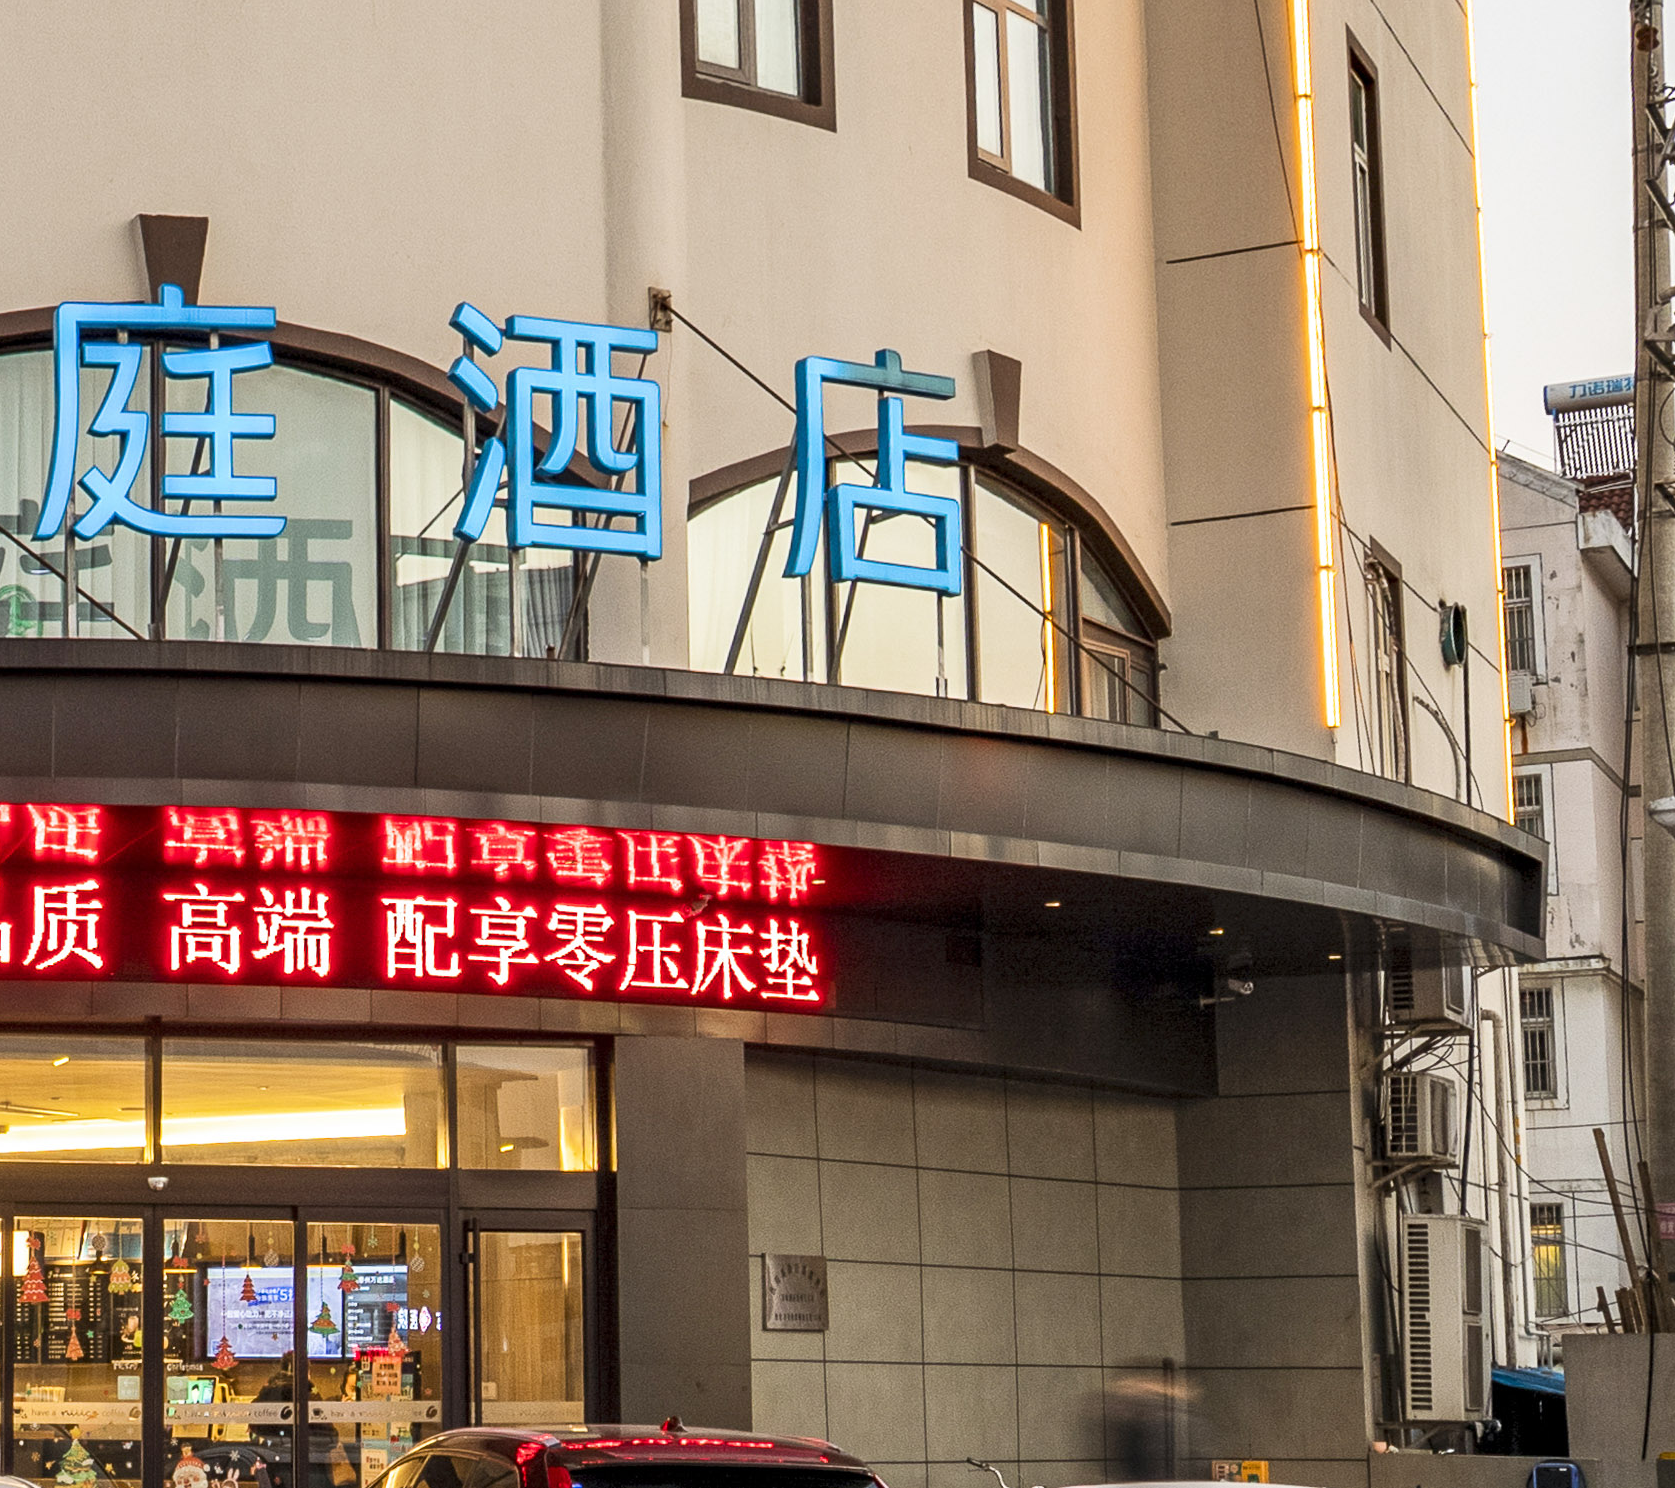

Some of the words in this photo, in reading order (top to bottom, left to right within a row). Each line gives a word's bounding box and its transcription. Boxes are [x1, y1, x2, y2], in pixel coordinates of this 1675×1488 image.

[162, 880, 333, 977] 高端
[380, 895, 821, 1004] 配享零压床垫
